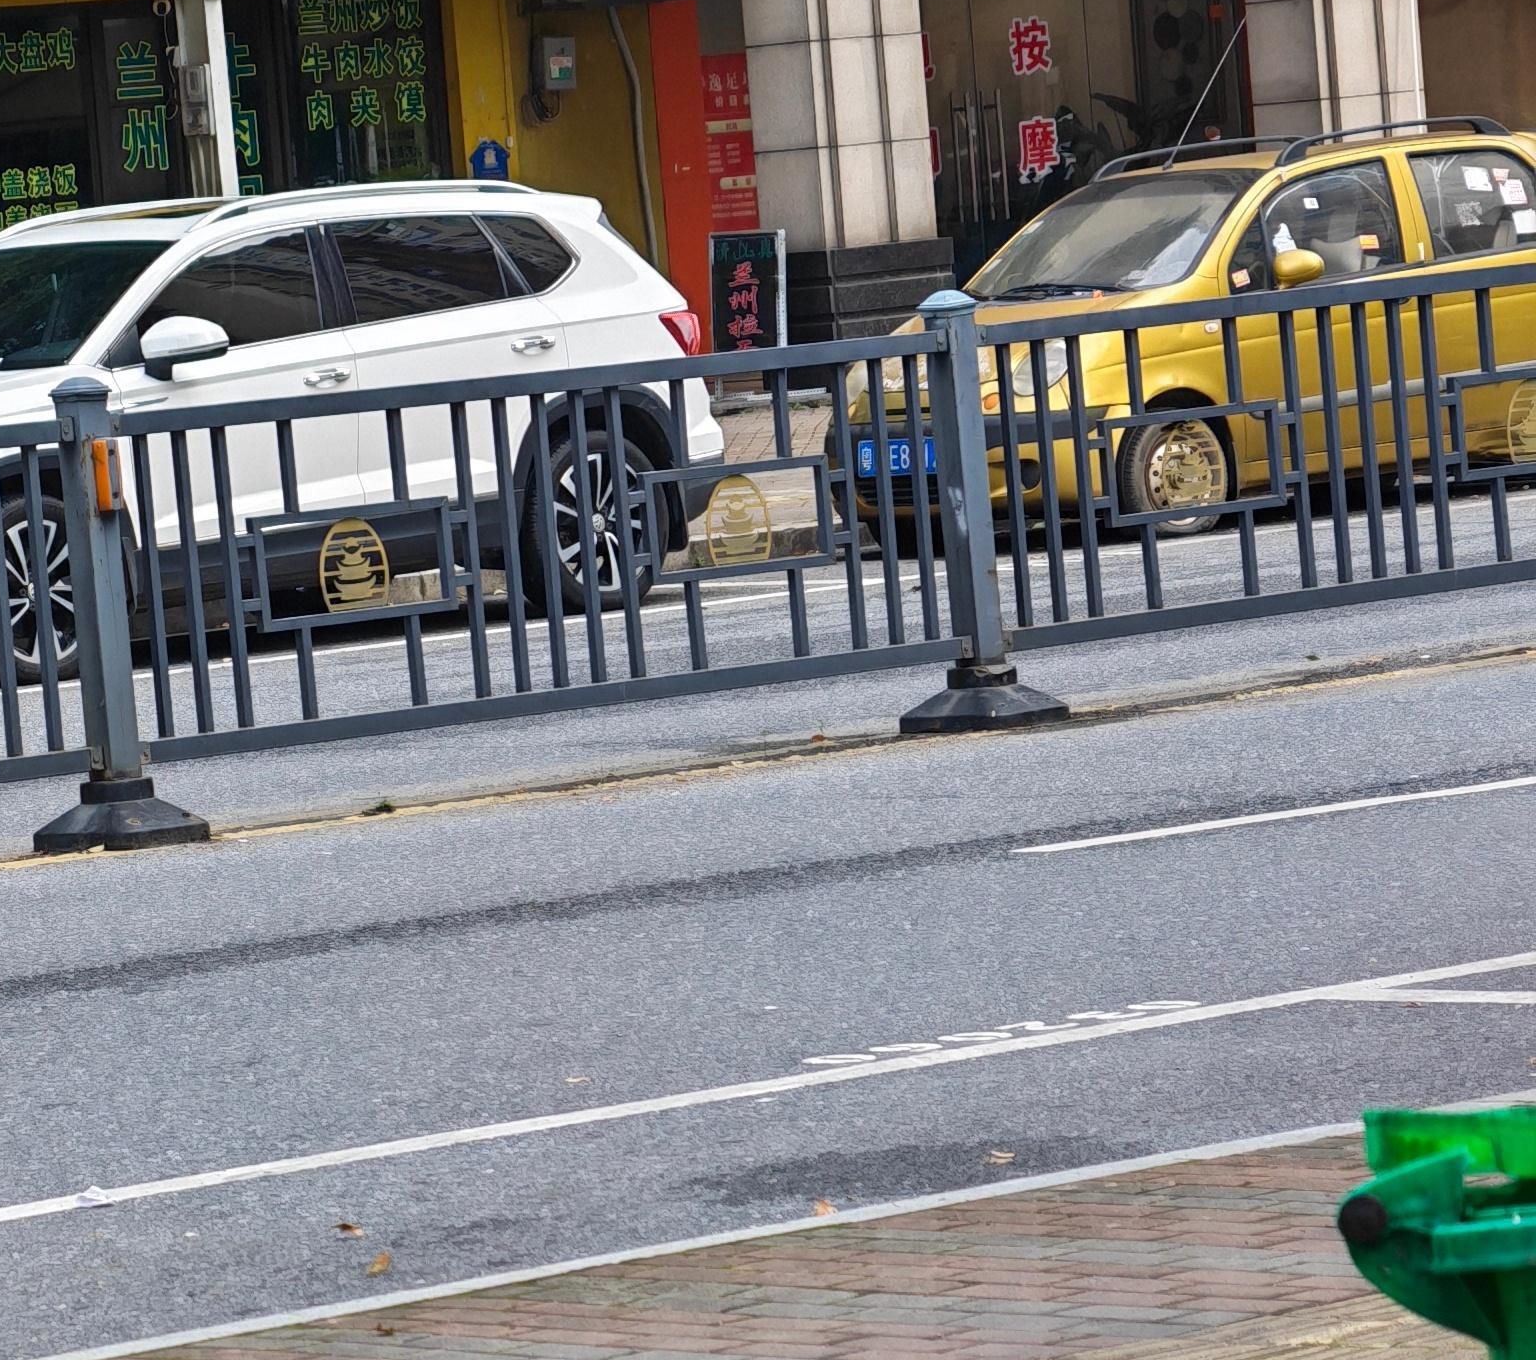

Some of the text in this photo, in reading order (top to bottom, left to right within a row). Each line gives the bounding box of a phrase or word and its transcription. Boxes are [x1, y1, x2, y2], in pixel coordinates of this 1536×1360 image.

[301, 35, 426, 83] 牛肉水饺
[1009, 15, 1060, 176] 按摩
[116, 41, 169, 173] 兰州
[306, 81, 426, 131] 肉夹馍
